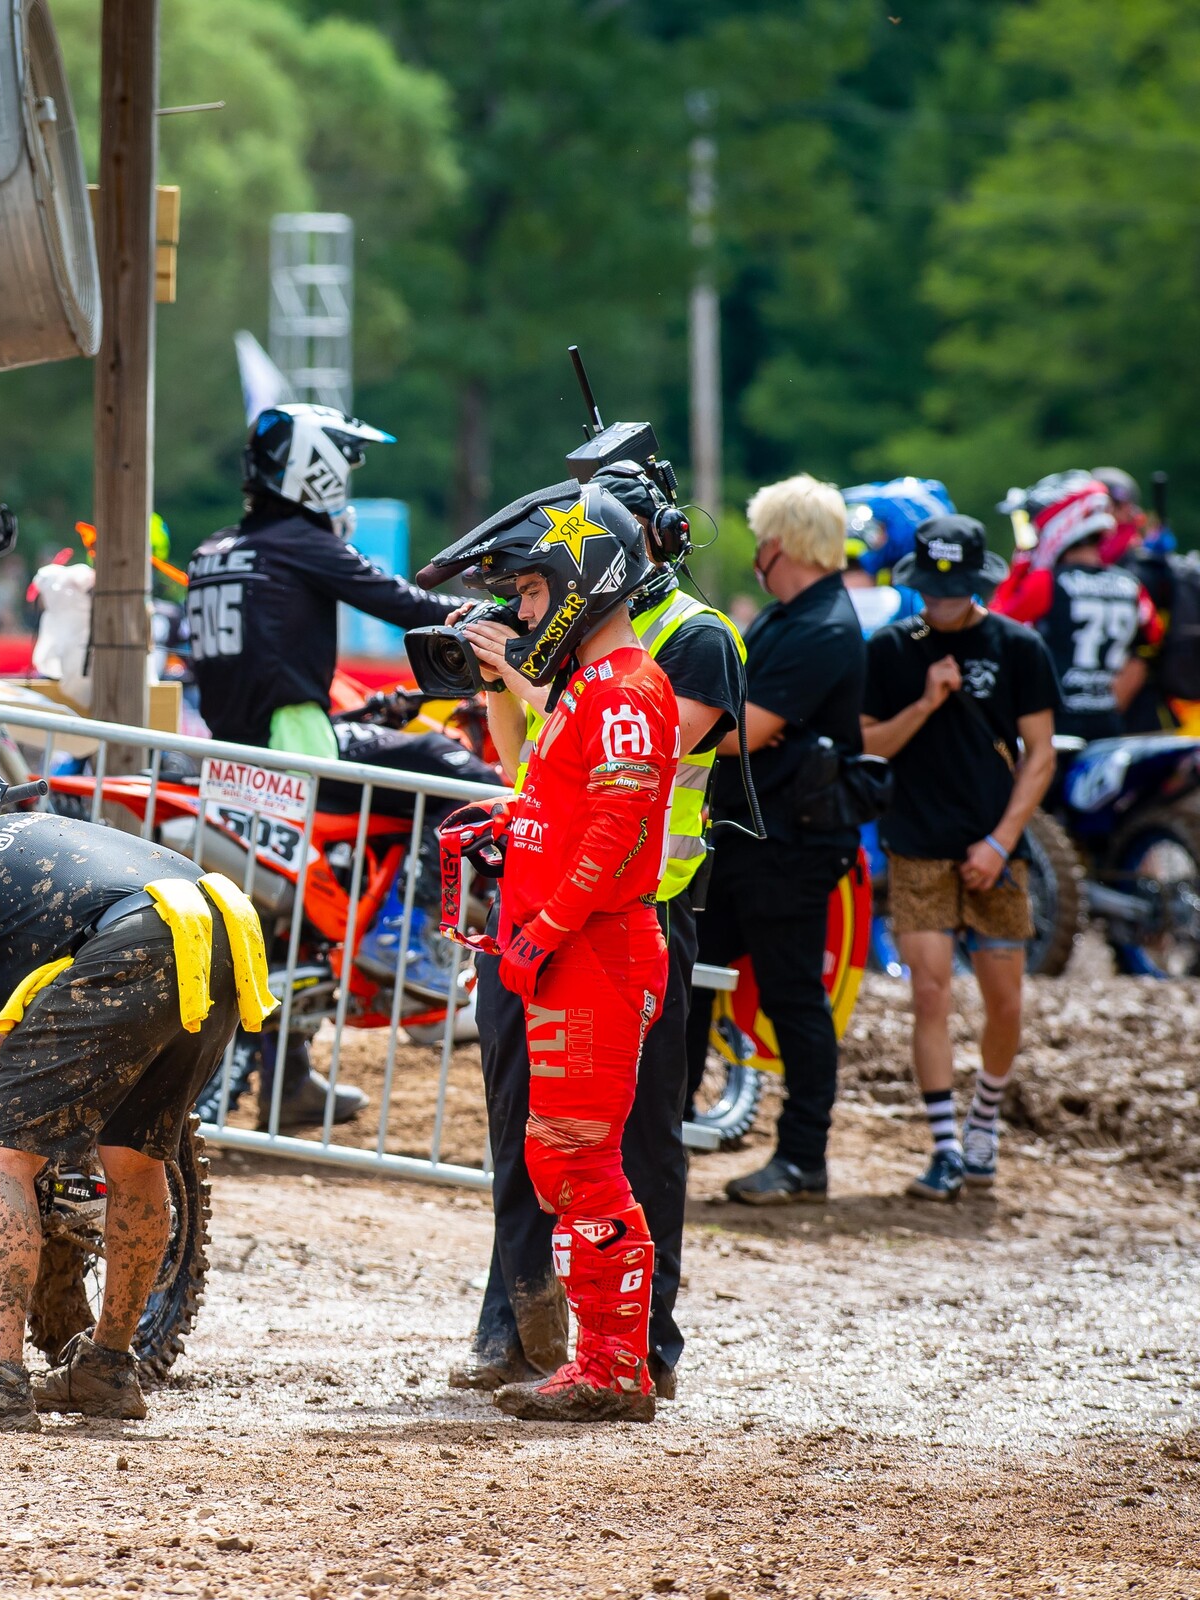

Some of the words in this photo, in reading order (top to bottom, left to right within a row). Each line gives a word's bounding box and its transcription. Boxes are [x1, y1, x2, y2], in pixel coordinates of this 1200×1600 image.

[189, 583, 244, 660] 505
[208, 760, 306, 801] NATIONAL
[218, 808, 300, 861] 503
[442, 850, 459, 917] OAKLEY
[571, 853, 603, 893] FLY
[511, 935, 546, 962] FLY
[526, 1002, 566, 1078] FLY
[567, 1008, 594, 1079] RACING
[67, 1186, 91, 1198] EXCEL
